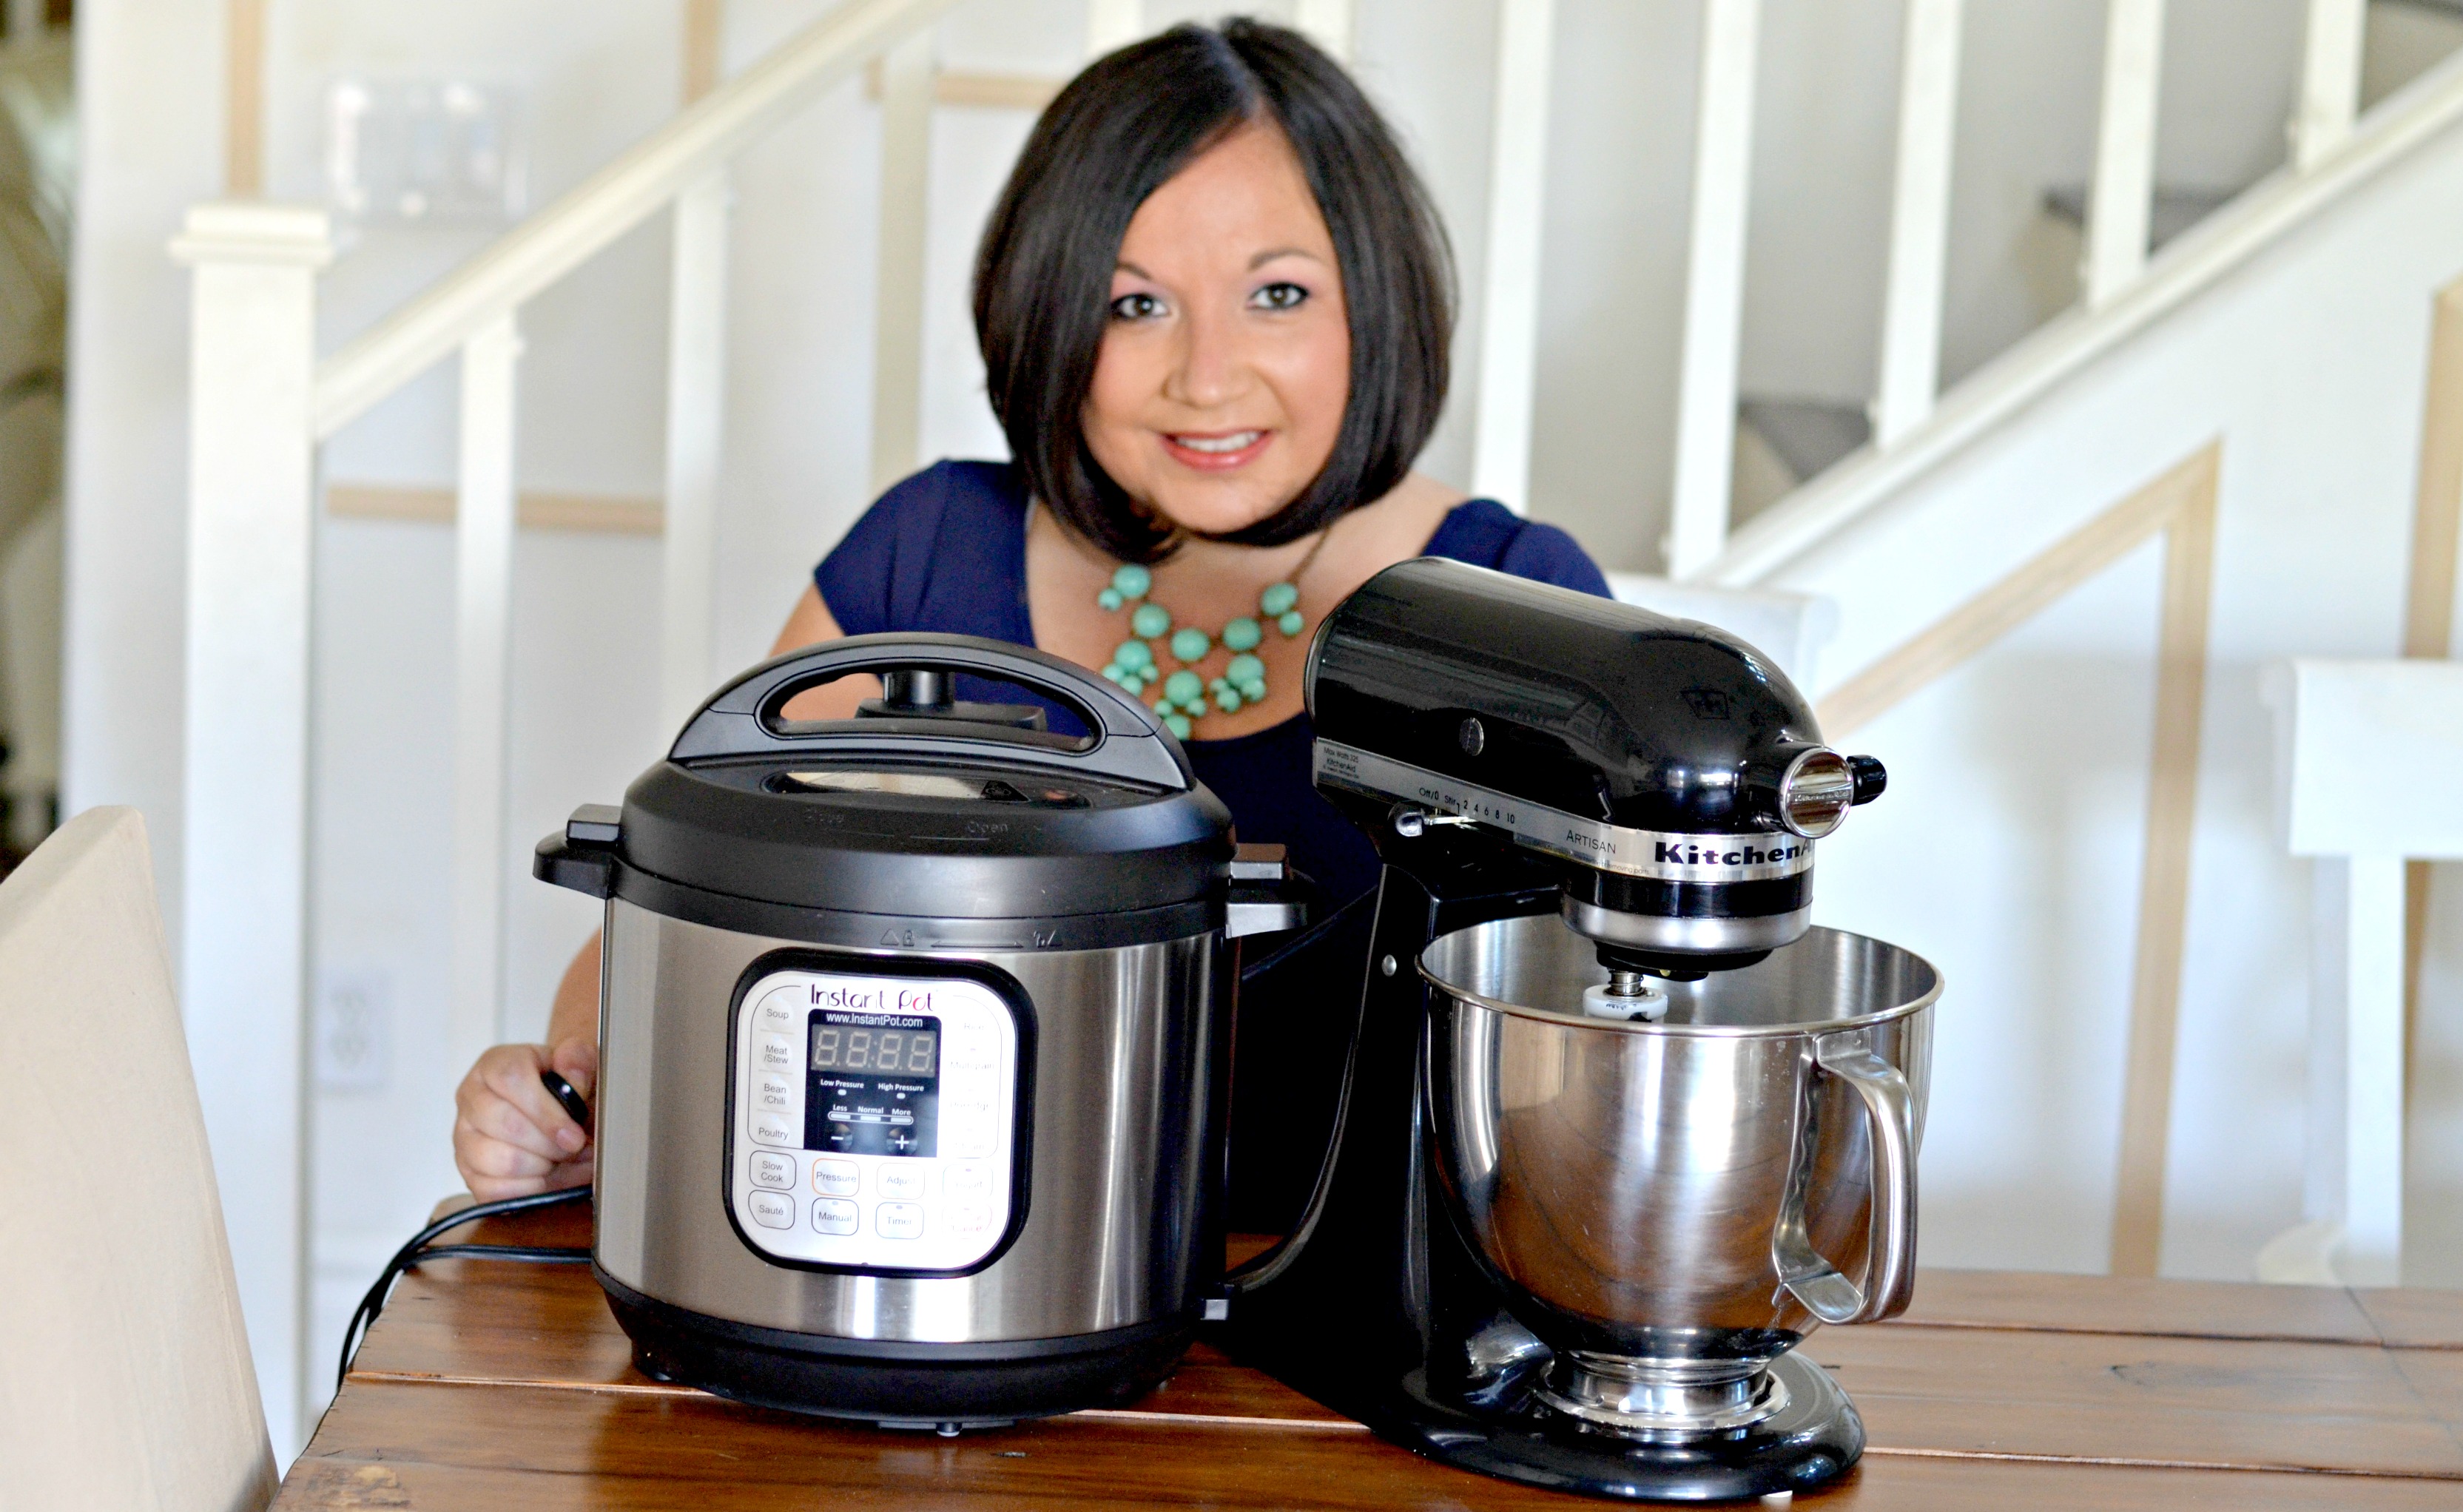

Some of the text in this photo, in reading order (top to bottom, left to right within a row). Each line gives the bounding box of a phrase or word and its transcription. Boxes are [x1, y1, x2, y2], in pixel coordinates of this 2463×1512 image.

[1444, 795, 1456, 805] Stir
[1463, 800, 1469, 810] 2
[1474, 803, 1478, 812] 4
[1484, 807, 1489, 816] 6
[1495, 810, 1500, 820] 8
[1507, 813, 1515, 824] 10
[811, 984, 934, 1011] Instant Pot
[766, 1008, 789, 1020] Soup
[826, 1012, 923, 1027] www.InstantPot.com
[766, 1044, 787, 1055] Meat
[764, 1053, 789, 1064] /Stew
[764, 1083, 786, 1093] Bean
[821, 1079, 864, 1089] Low Pressure
[878, 1083, 924, 1092] High Pressure
[764, 1095, 786, 1105] /Chili
[833, 1104, 847, 1112] Less
[857, 1106, 884, 1114] Normal
[758, 1127, 789, 1141] Poultry
[762, 1160, 784, 1171] Slow
[761, 1172, 784, 1183] Cook
[816, 1171, 857, 1183] Pressure
[759, 1204, 784, 1215] Sauté
[818, 1212, 852, 1222] Manual
